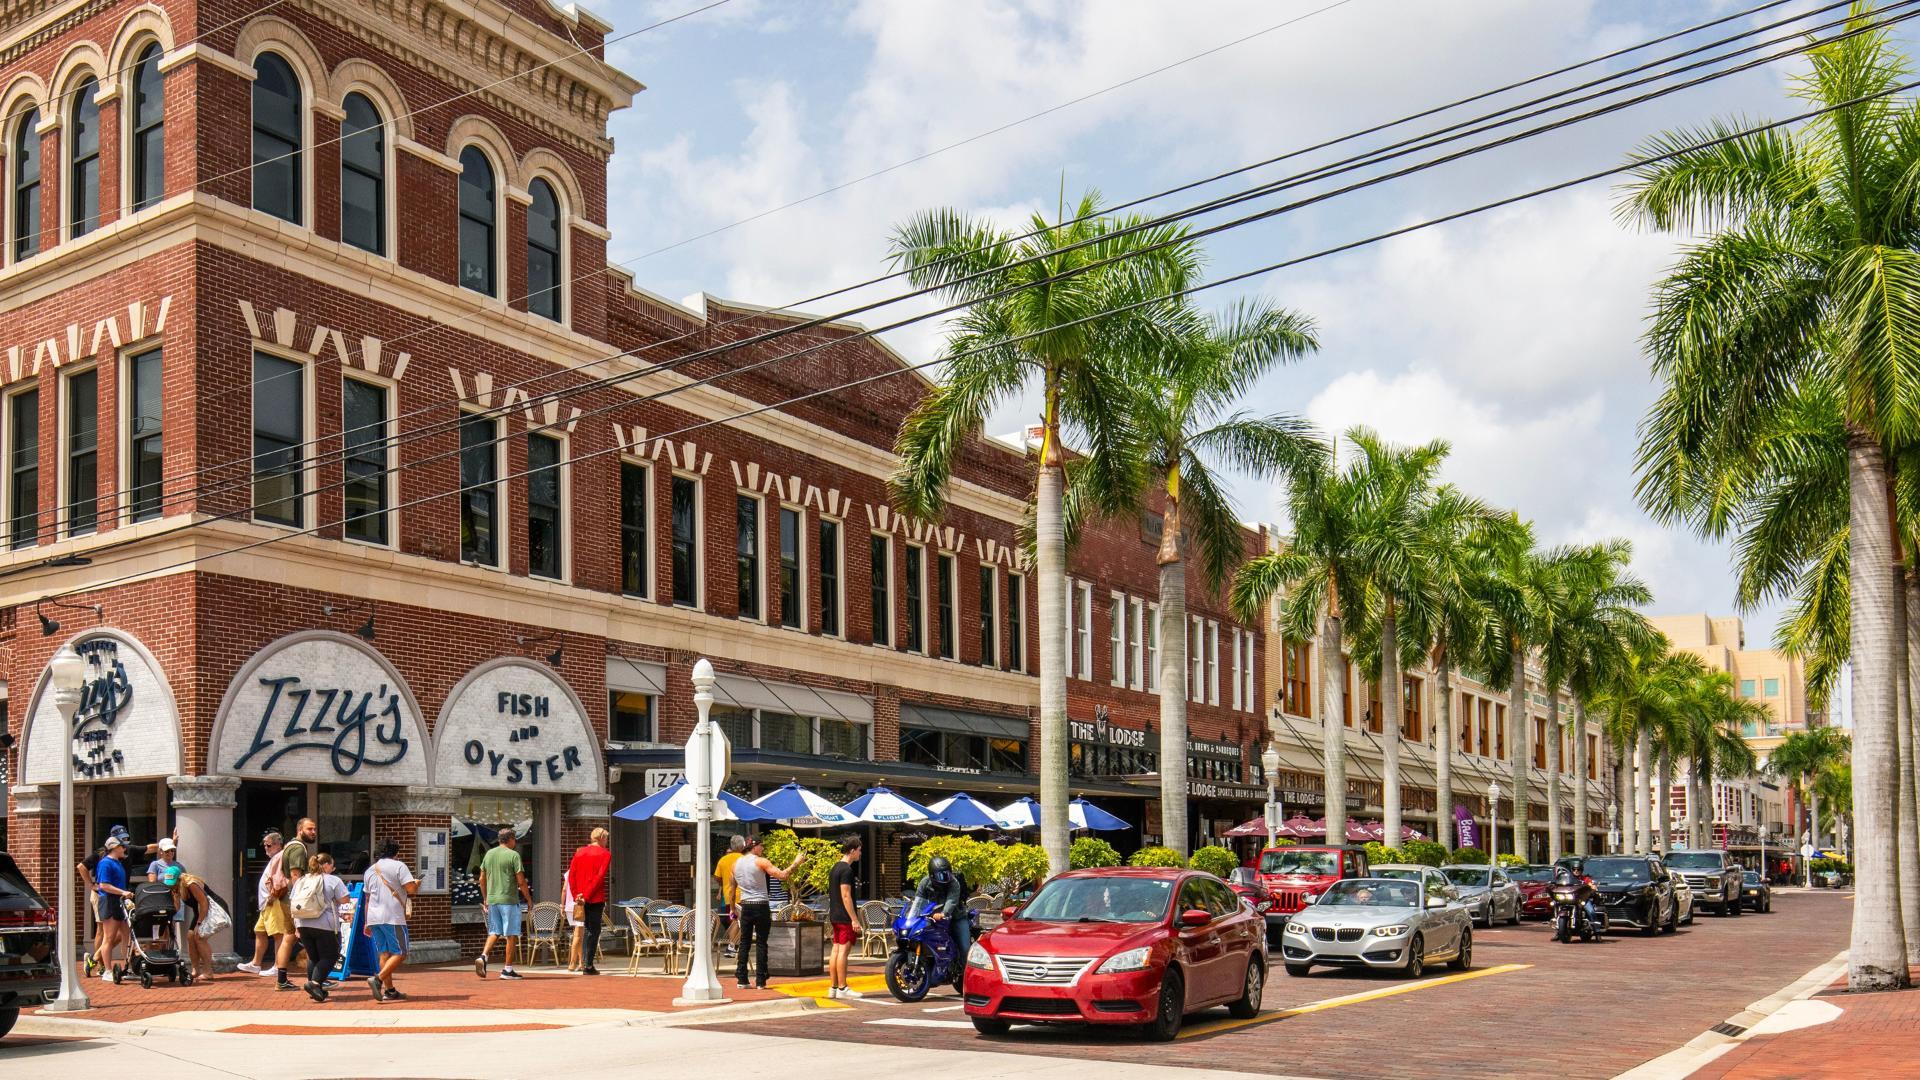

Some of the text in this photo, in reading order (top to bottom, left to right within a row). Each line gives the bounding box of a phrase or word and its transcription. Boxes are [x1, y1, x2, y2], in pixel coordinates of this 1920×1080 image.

[498, 692, 549, 717] FISH
[233, 677, 408, 776] Izzy's
[509, 725, 539, 742] AND
[1070, 721, 1145, 747] THE LODGE
[464, 740, 581, 785] OYSTER
[1191, 782, 1217, 798] LODGE
[1284, 791, 1296, 803] THE
[1296, 792, 1315, 805] LODGE
